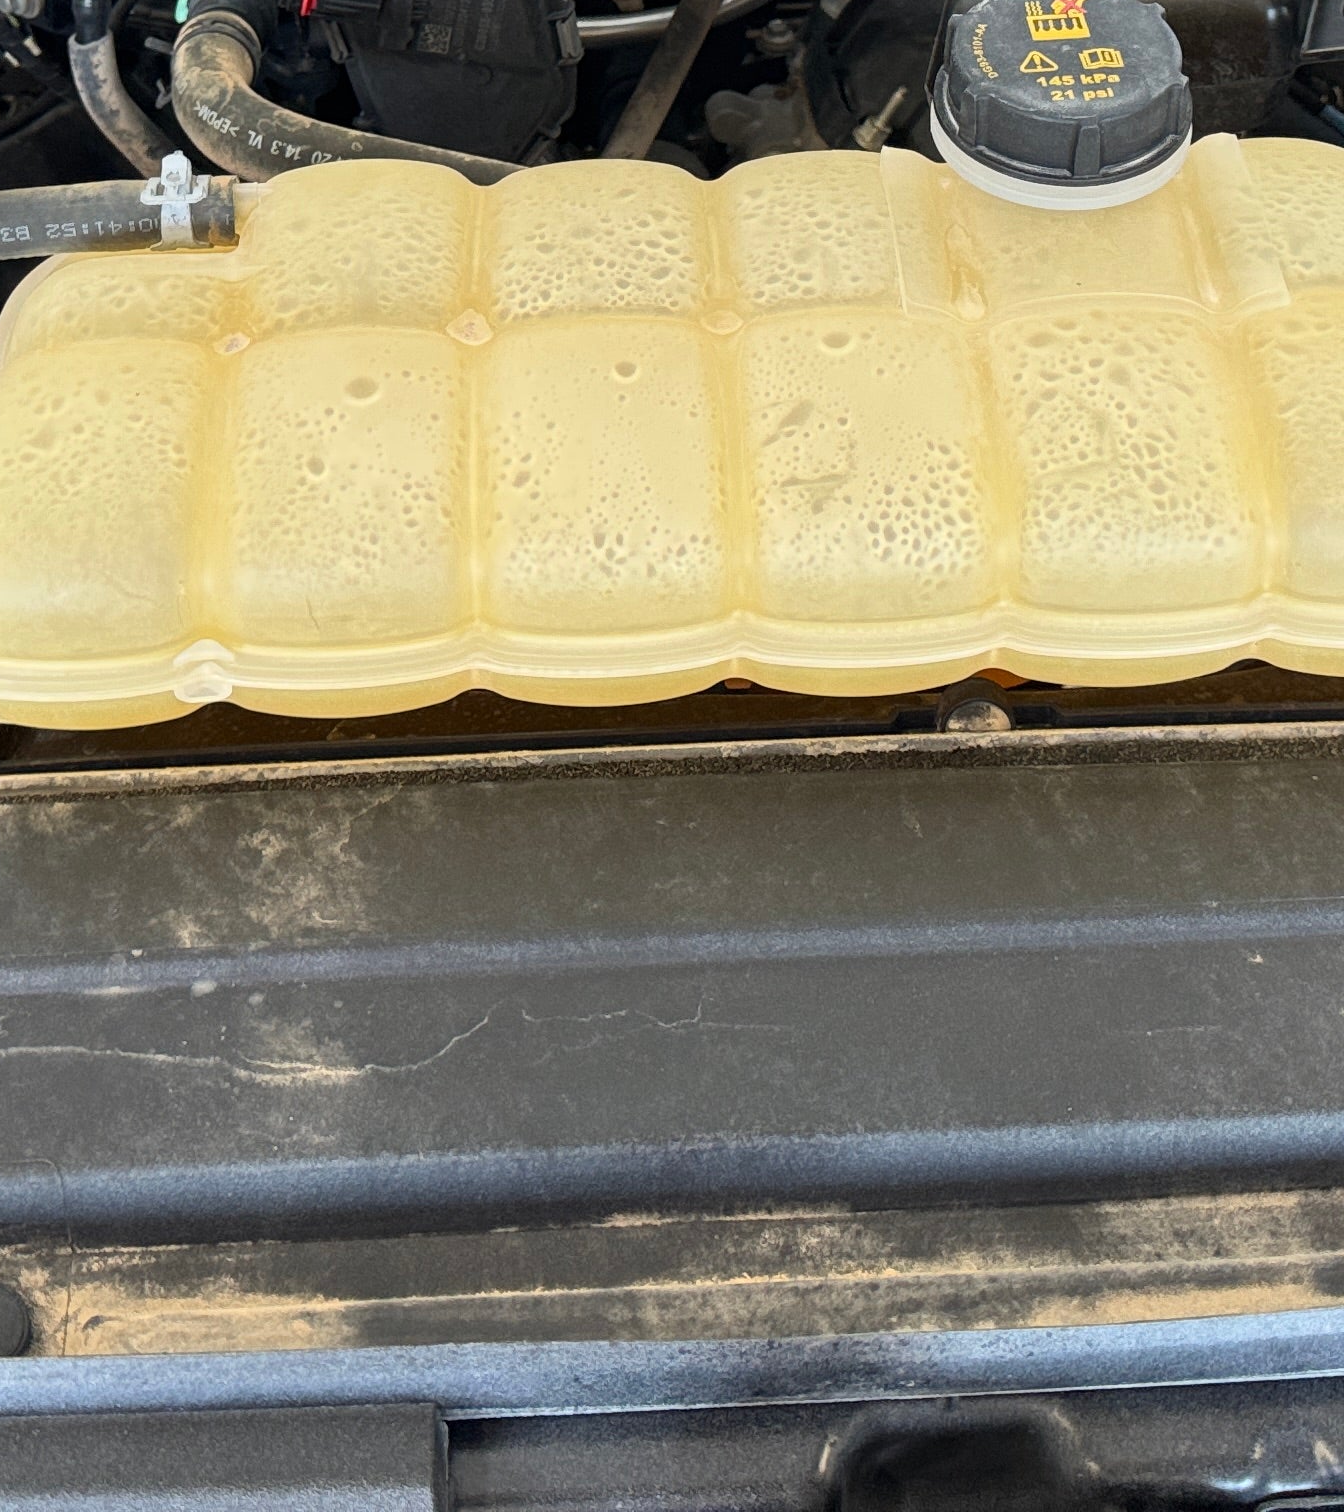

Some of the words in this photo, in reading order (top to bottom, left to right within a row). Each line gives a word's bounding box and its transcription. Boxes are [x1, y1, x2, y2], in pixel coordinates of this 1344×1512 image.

[1036, 74, 1075, 87] 145
[1080, 73, 1121, 85] kPa
[1050, 89, 1076, 101] 21
[1082, 87, 1115, 101] psi
[247, 129, 263, 149] VL
[0, 224, 31, 243] B3
